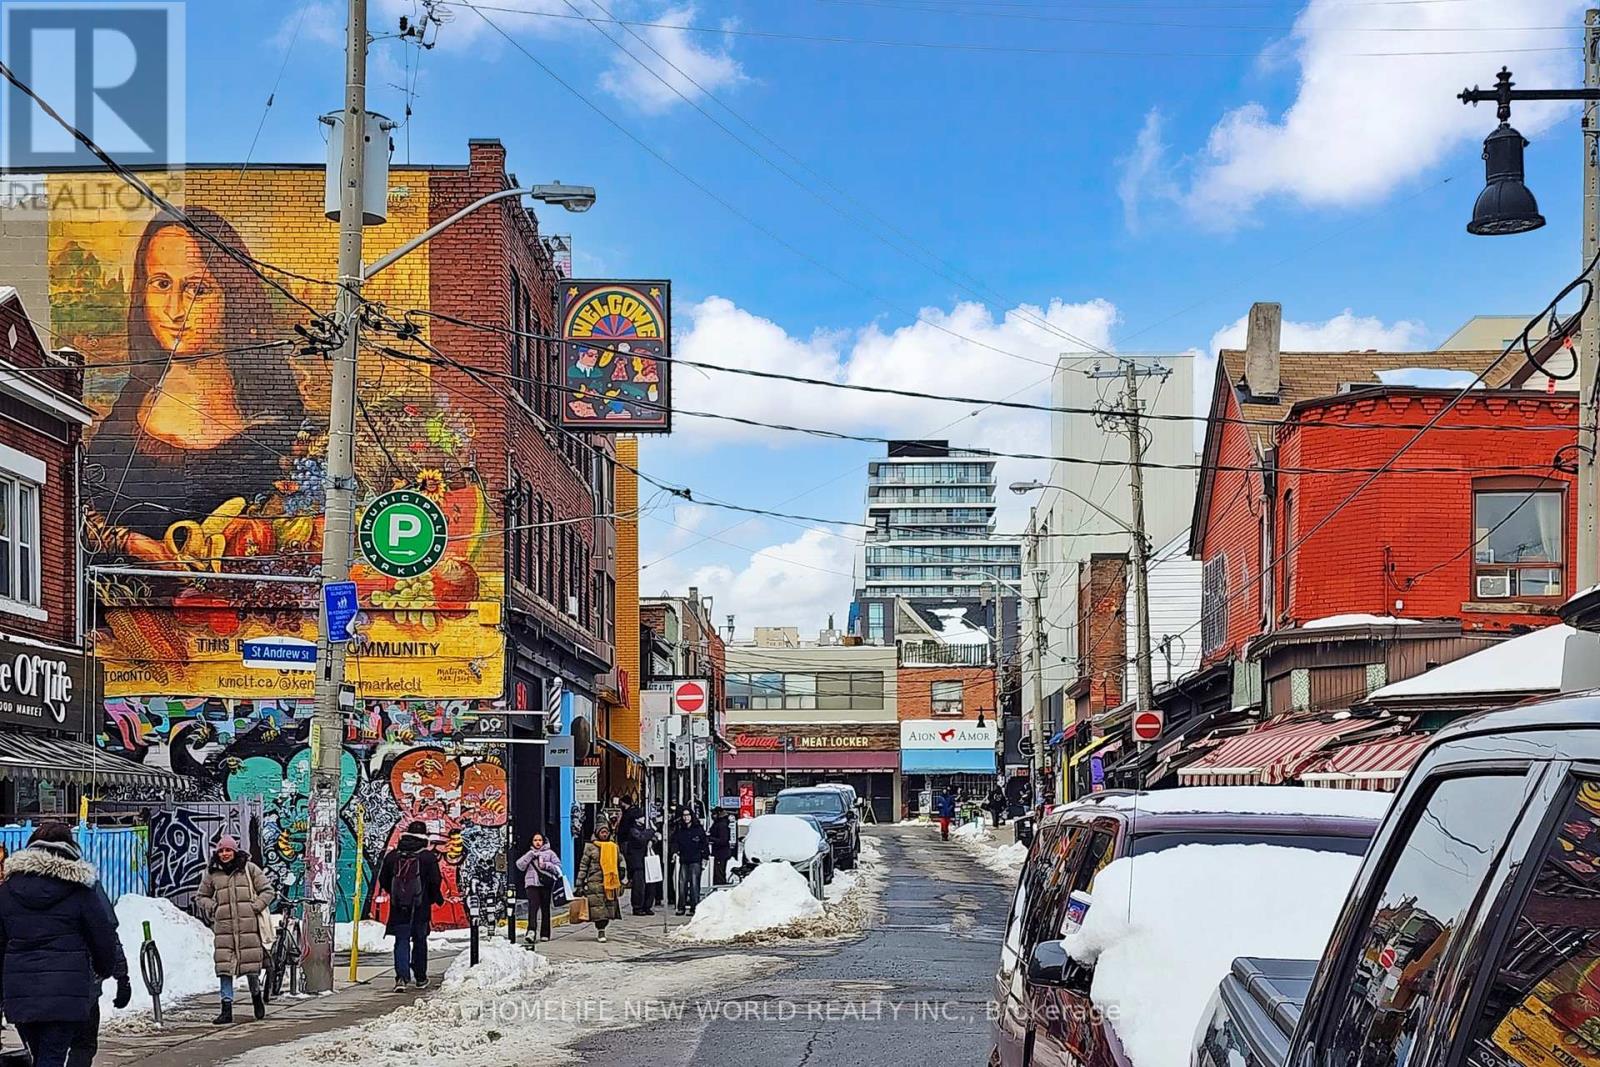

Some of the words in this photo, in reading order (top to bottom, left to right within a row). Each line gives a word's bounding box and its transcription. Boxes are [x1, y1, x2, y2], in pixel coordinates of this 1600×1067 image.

[572, 294, 656, 337] WELCOME
[363, 494, 443, 532] MUNICIPAL
[388, 513, 422, 547] P
[363, 540, 442, 575] PARKING
[195, 638, 230, 653] THIS
[251, 645, 261, 658] St
[262, 646, 300, 659] Andrew
[301, 650, 309, 660] St
[103, 670, 152, 682] TORONTO
[16, 703, 43, 717] MARKET
[801, 736, 828, 747] MEAT
[830, 736, 869, 747] LOCKER
[908, 731, 936, 741] AION
[958, 731, 991, 741] AMOR
[583, 757, 600, 766] ATM
